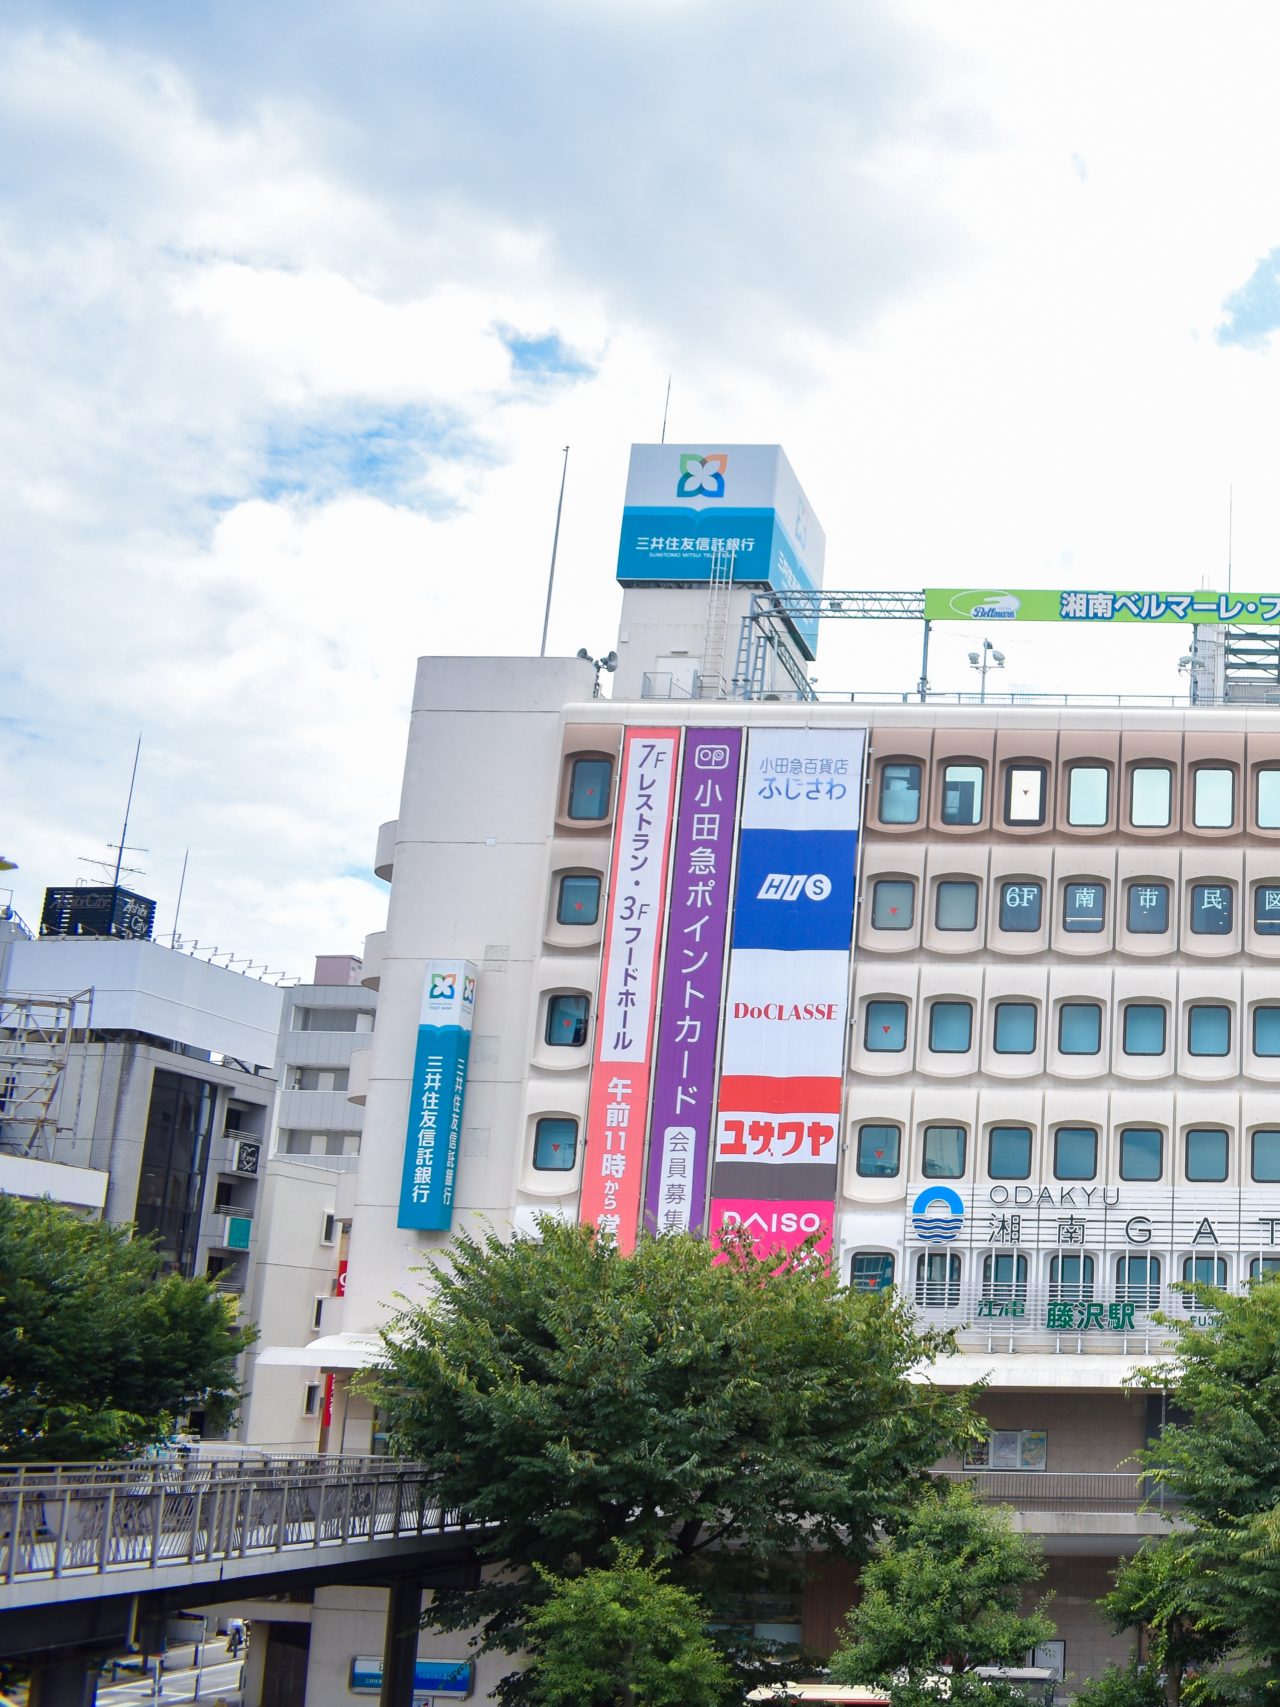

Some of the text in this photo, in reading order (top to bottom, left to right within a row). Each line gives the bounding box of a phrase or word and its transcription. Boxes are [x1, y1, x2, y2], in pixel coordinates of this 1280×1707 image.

[636, 536, 755, 552] 三井住友信託銀行
[760, 757, 849, 775] 小田急百貨店
[758, 778, 848, 801] ふじさわ
[131, 915, 149, 934] City
[674, 779, 723, 1115] 小田急ポイントカード
[734, 1002, 839, 1021] DoCLASSE
[412, 1055, 444, 1204] 三井住友信託銀行
[664, 1131, 690, 1230] 会員募集
[989, 1185, 1121, 1207] ODAKYU
[722, 1211, 821, 1233] DAISO
[1046, 1301, 1135, 1330] 藤沢駅
